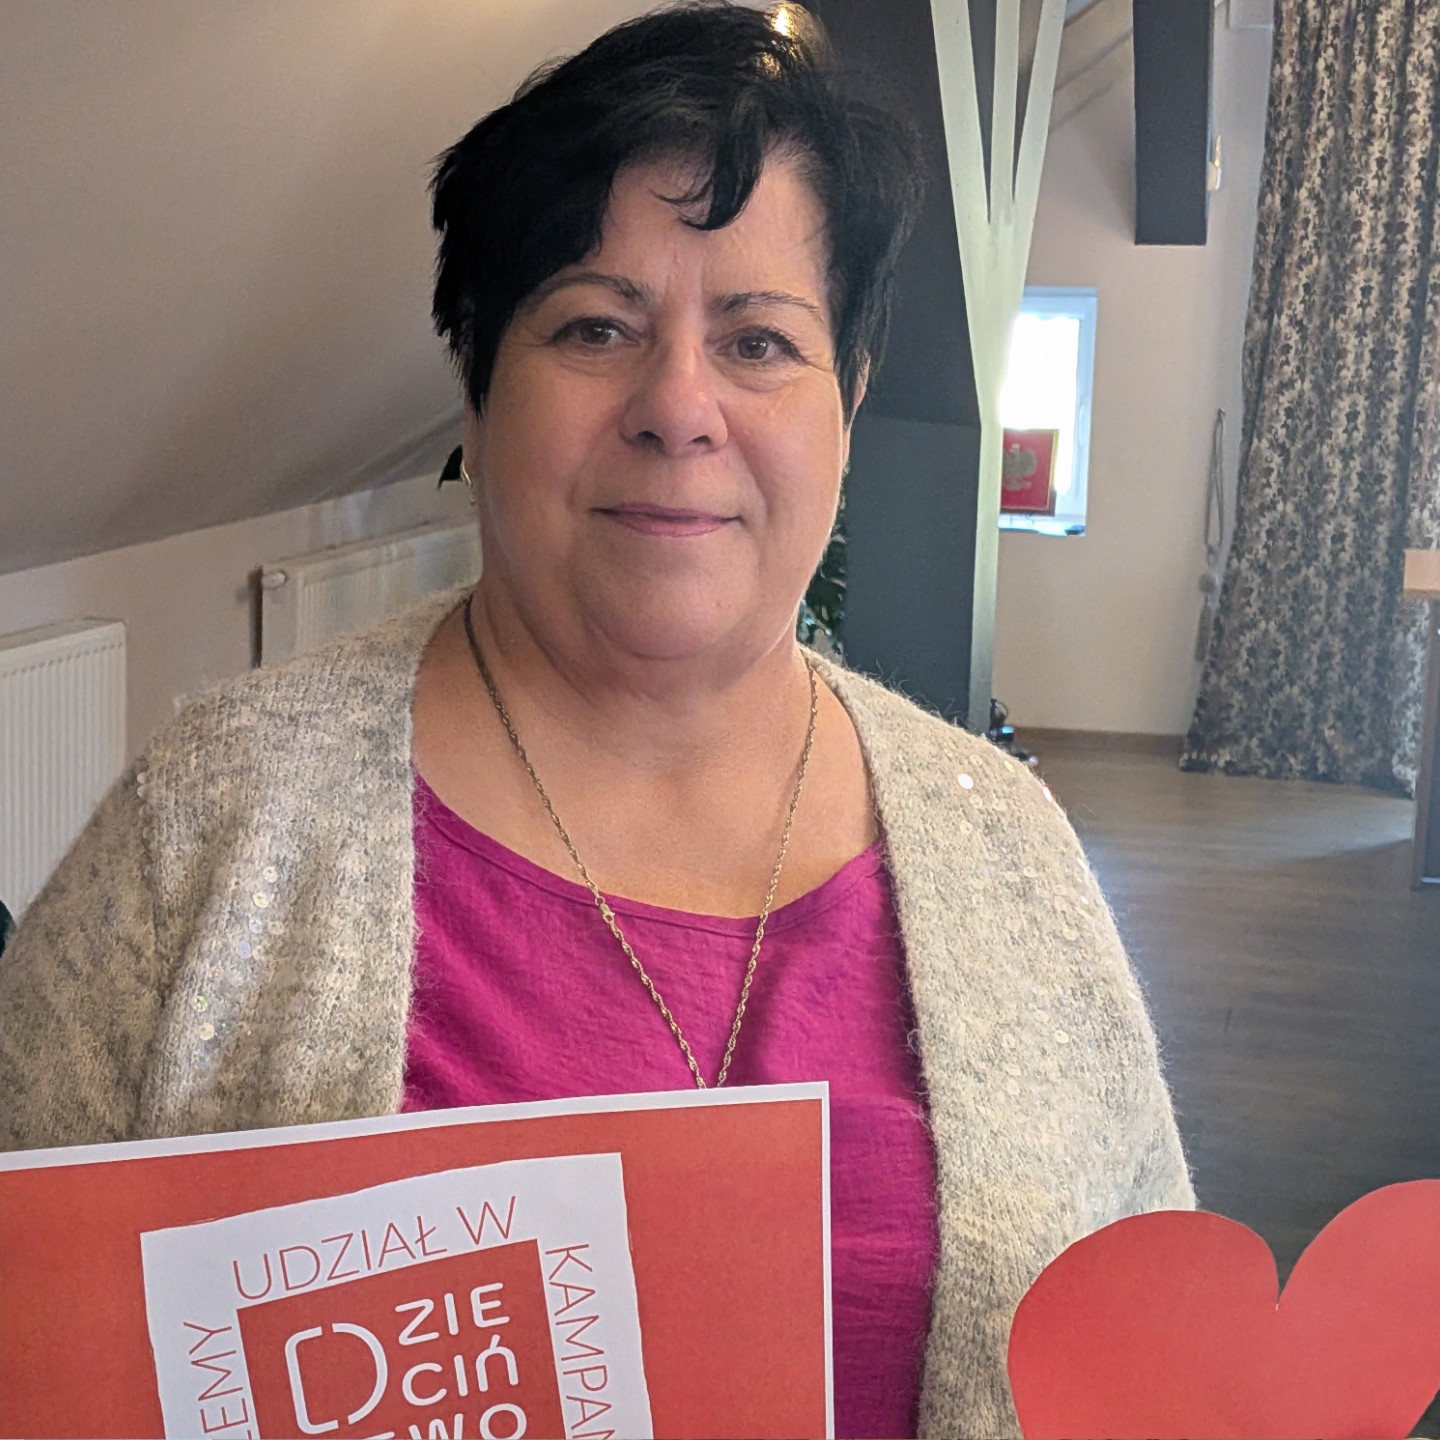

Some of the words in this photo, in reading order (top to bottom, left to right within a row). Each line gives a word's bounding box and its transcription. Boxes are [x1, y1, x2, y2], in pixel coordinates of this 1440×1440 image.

[232, 1215, 448, 1301] UDZIAŁ
[456, 1195, 516, 1245] W
[545, 1243, 616, 1439] KAMPA
